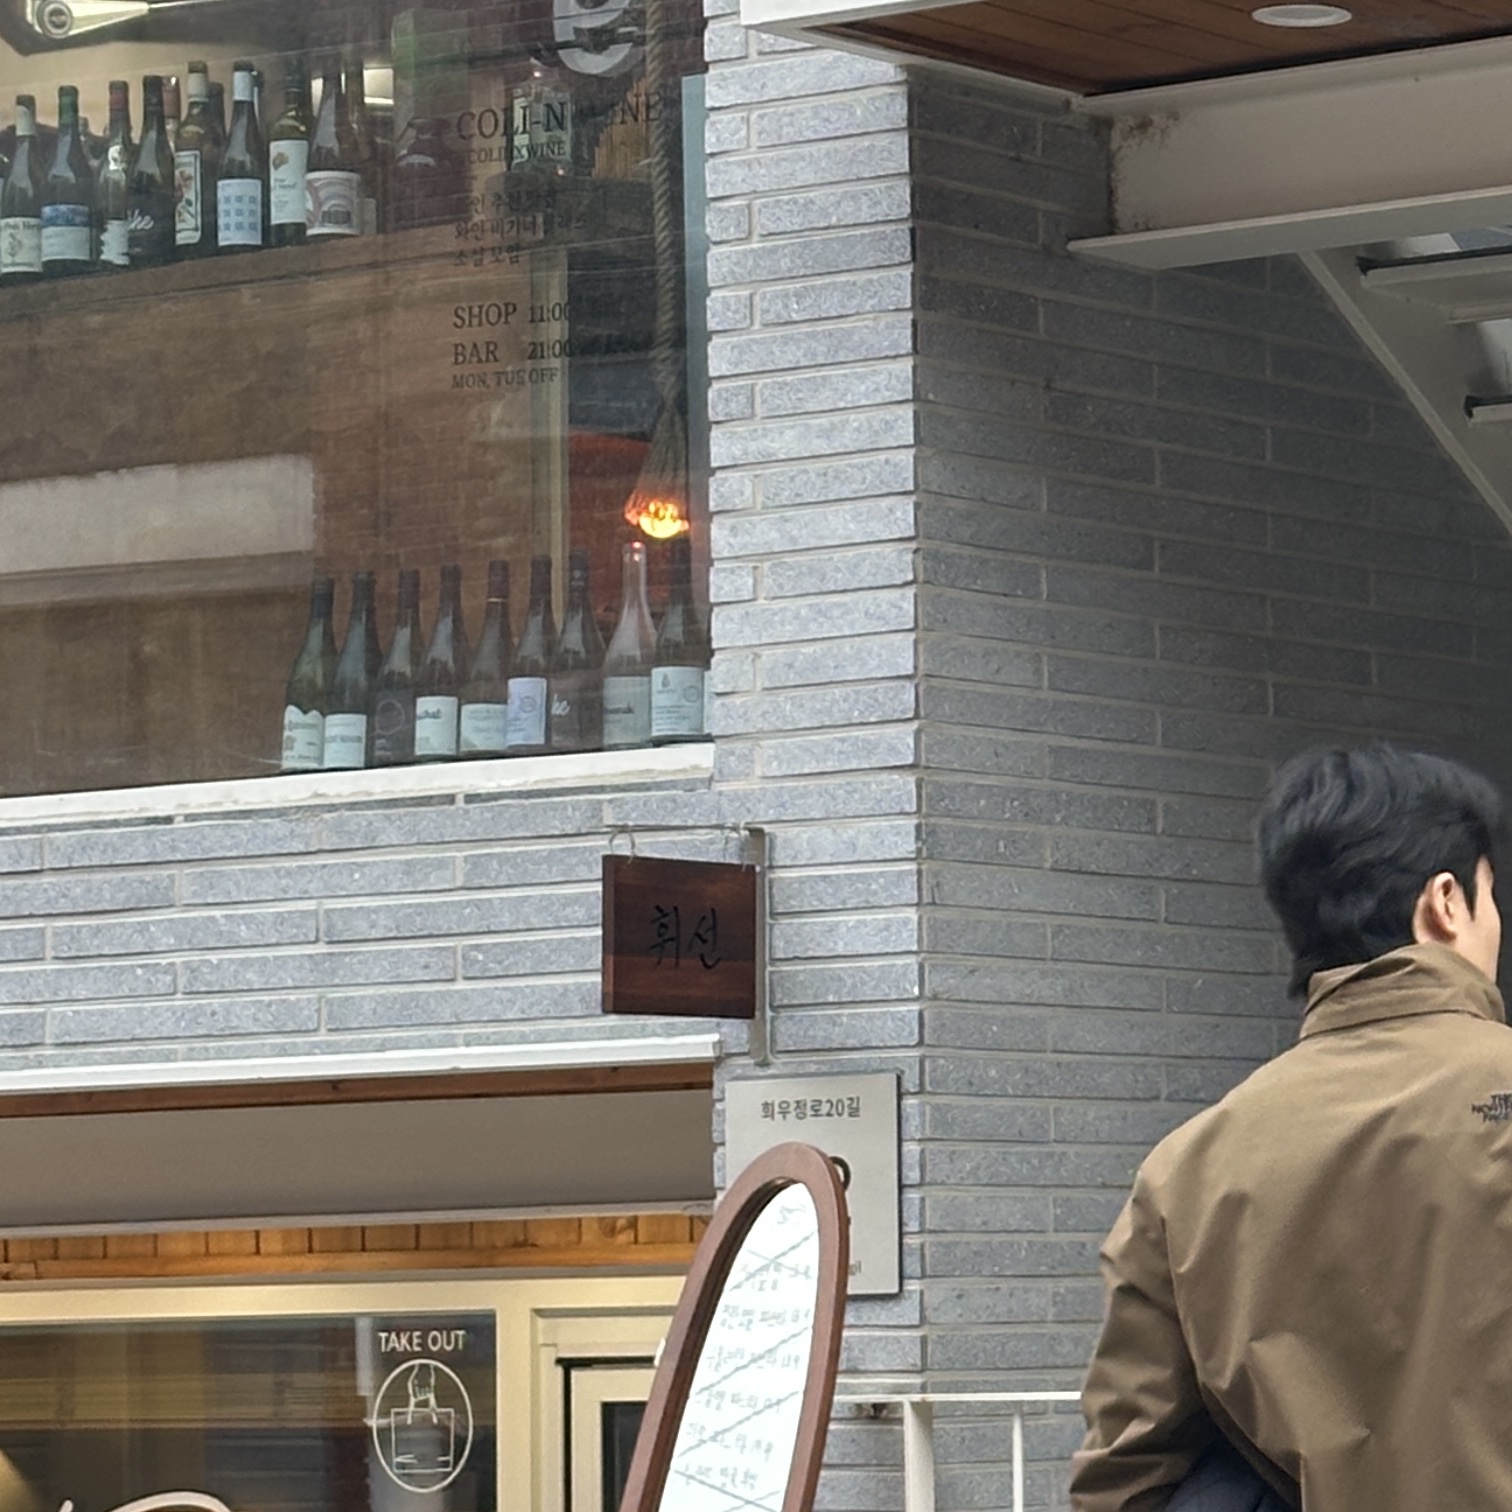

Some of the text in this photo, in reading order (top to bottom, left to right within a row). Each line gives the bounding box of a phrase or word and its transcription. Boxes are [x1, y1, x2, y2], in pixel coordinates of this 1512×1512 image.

[452, 302, 518, 329] SHOP
[452, 341, 499, 365] BAR
[761, 1096, 861, 1121] 희우정로20길
[378, 1329, 466, 1352] TAKE OUT
